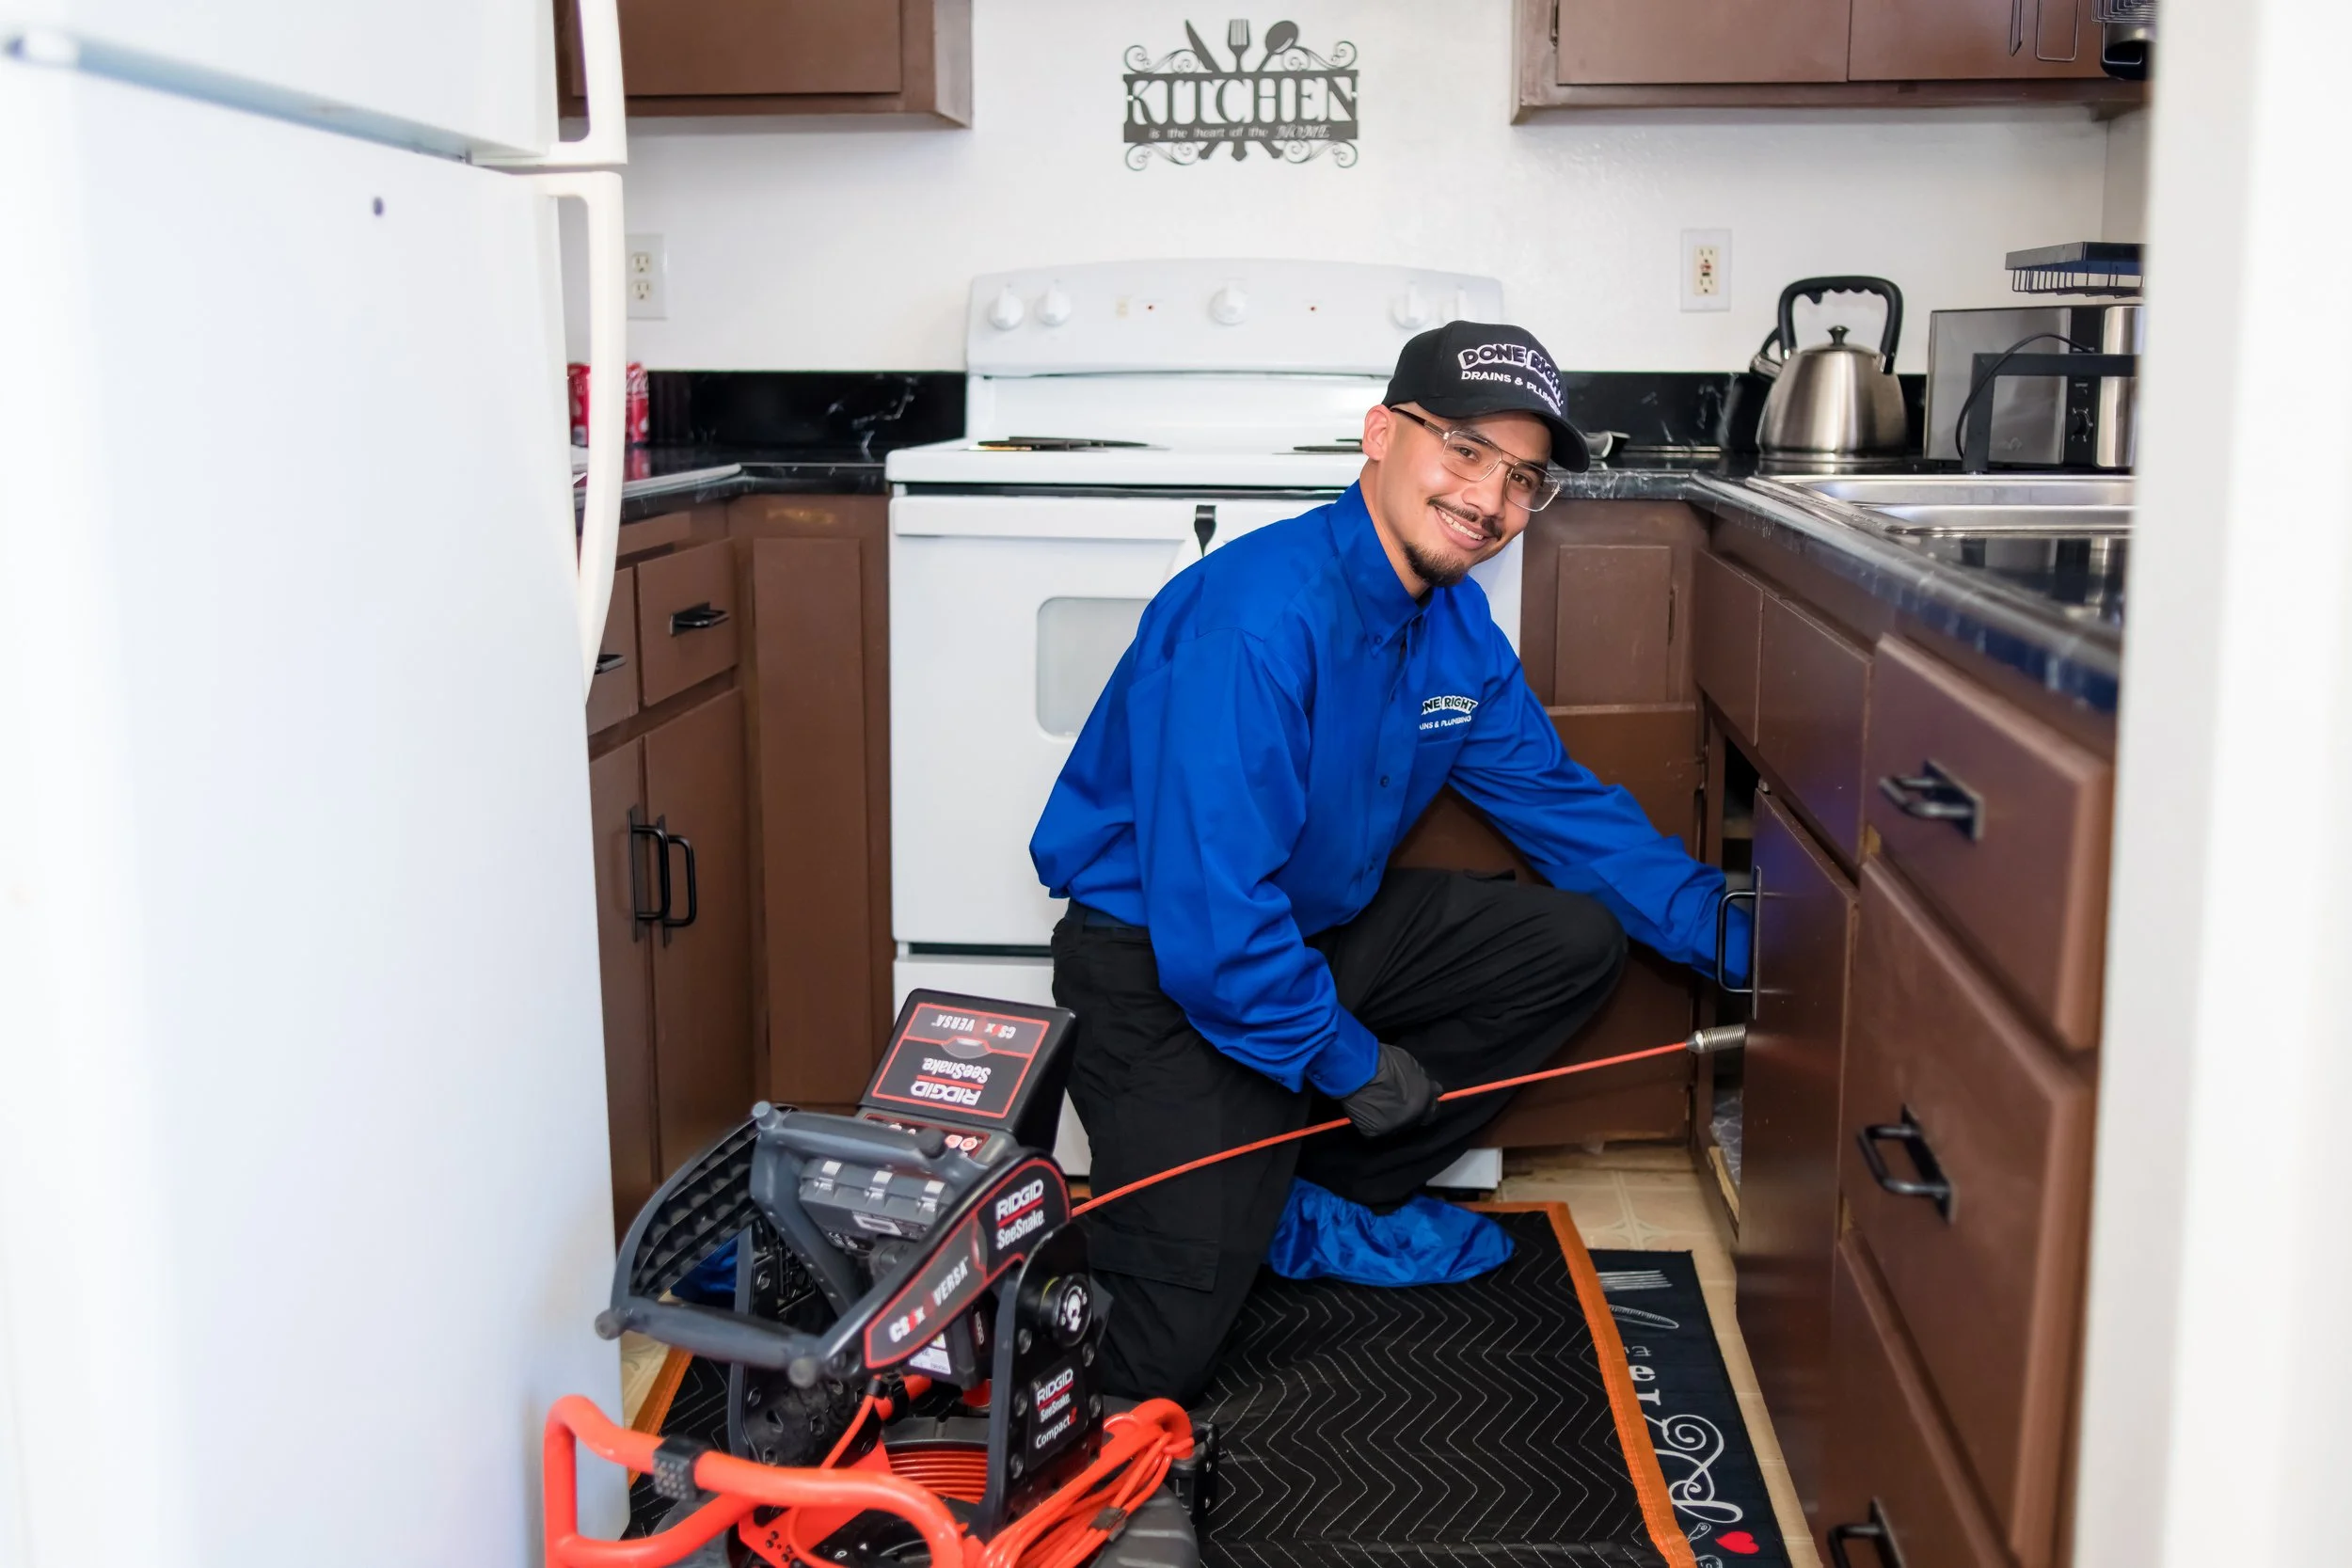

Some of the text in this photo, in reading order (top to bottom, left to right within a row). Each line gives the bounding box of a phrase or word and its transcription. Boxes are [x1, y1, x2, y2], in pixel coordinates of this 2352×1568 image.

[1125, 71, 1358, 125] KITCHEN
[1168, 127, 1187, 138] the
[1193, 127, 1224, 138] heart
[1229, 126, 1244, 137] of
[1248, 126, 1268, 137] the
[1458, 343, 1526, 370] DONE
[1461, 371, 1562, 416] DRAINS & PLUMB
[1422, 695, 1478, 715] NE RIGHT
[922, 1057, 992, 1084] SeeSnake
[910, 1081, 982, 1106] RIDGID
[995, 1179, 1044, 1222] RIDGID
[996, 1209, 1044, 1250] SeeSnake
[1037, 1368, 1073, 1406] RIDGID
[1041, 1393, 1071, 1423] SeeSnake
